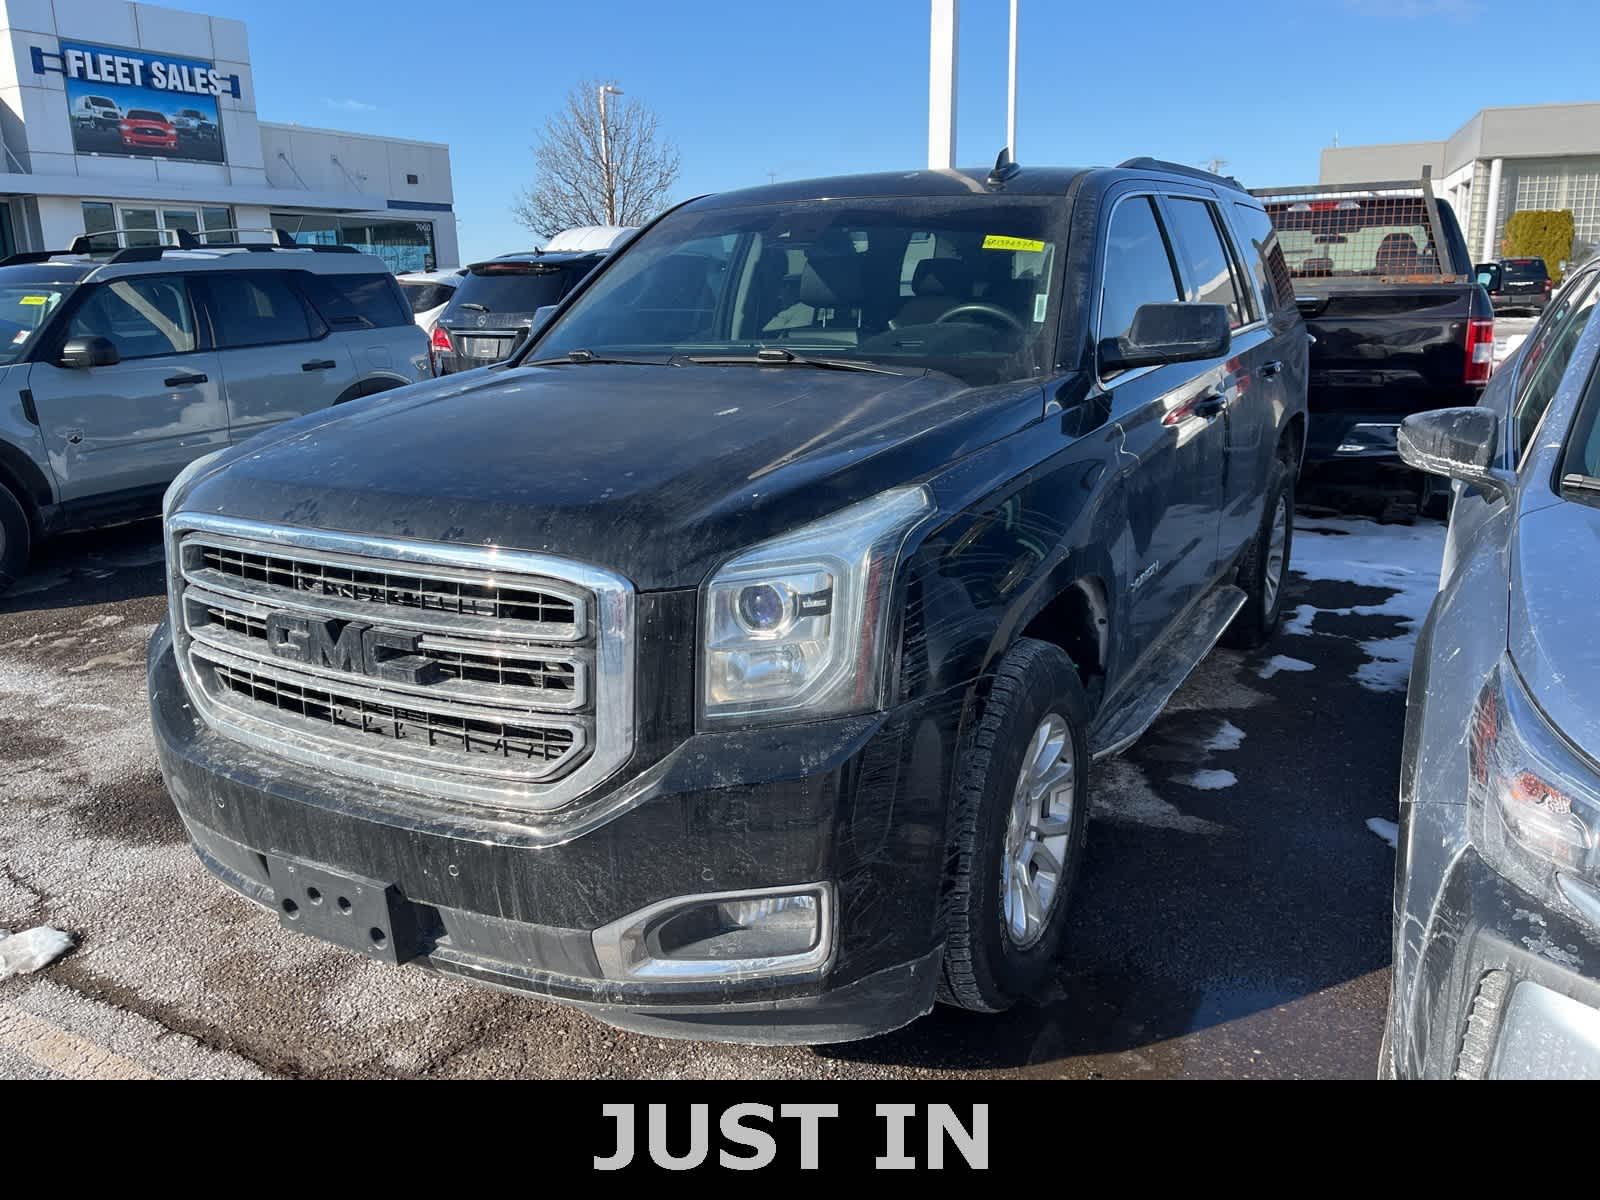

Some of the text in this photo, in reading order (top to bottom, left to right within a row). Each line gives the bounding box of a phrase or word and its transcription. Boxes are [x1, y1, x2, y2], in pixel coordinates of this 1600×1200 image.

[65, 49, 223, 96] FLEET SALES
[266, 609, 441, 685] GMC
